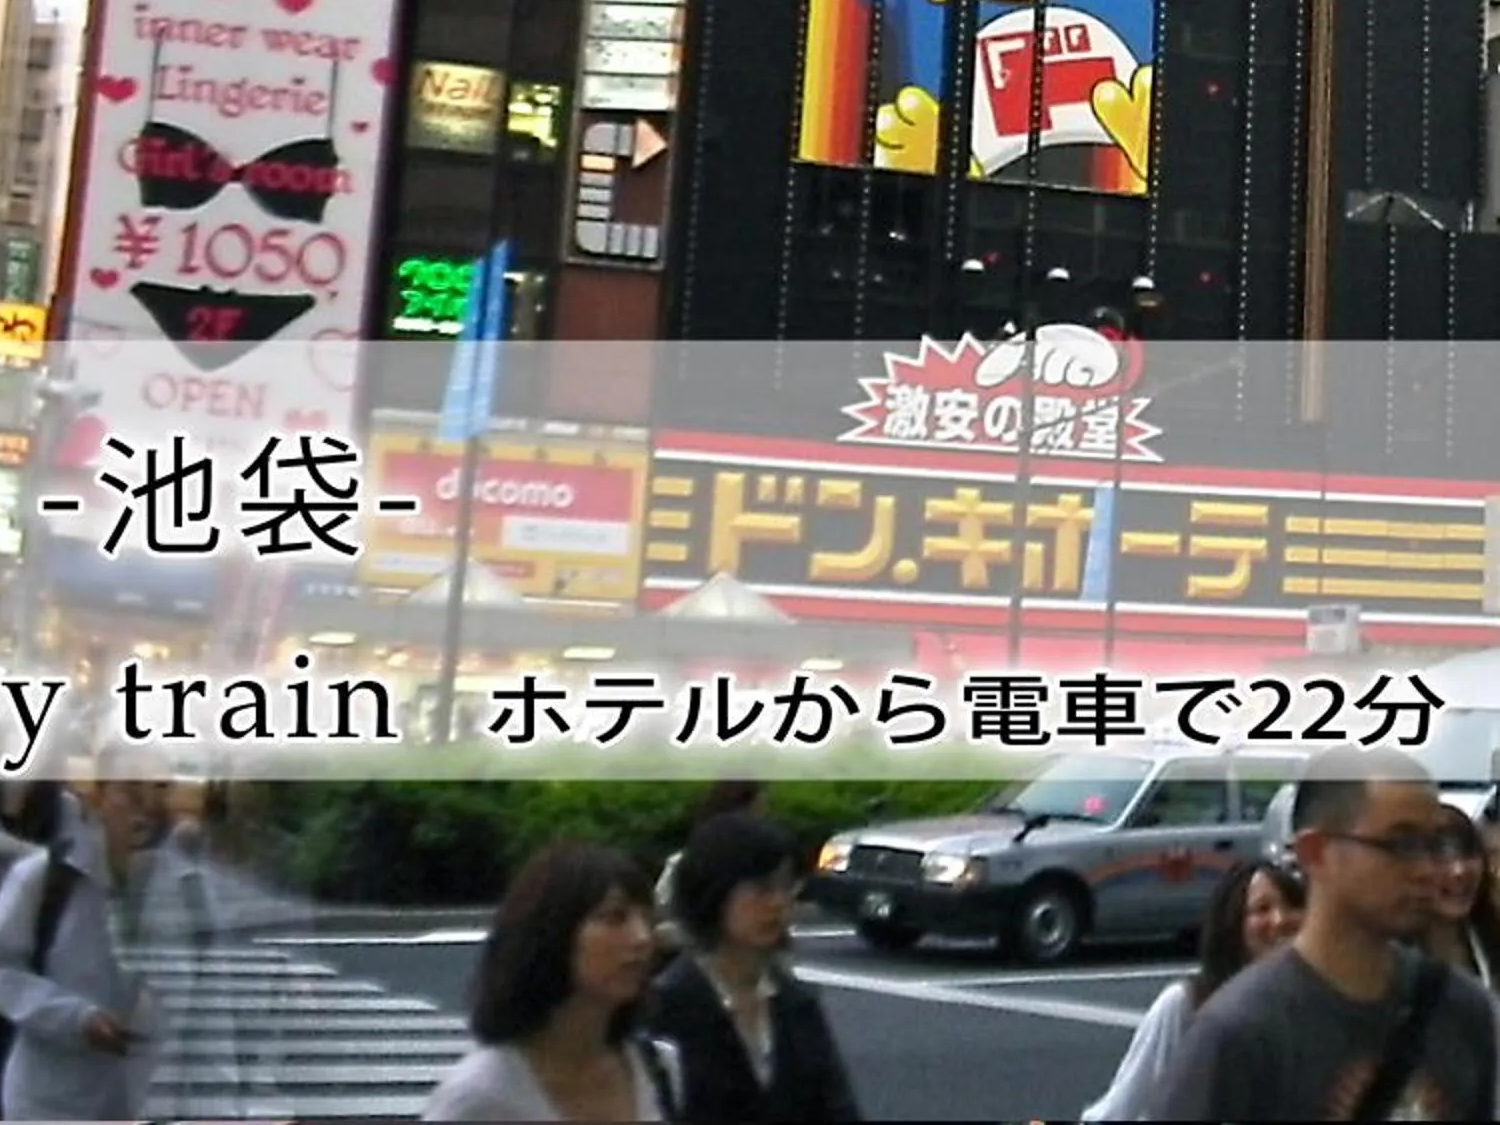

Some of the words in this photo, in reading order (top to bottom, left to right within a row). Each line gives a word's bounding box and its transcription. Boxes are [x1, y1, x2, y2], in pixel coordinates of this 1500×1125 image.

[133, 3, 250, 51] inner
[260, 25, 362, 63] wear
[155, 63, 329, 121] Lingerie
[141, 372, 269, 422] OPEN
[882, 383, 1122, 453] 激安の殿堂
[434, 469, 575, 509] dcomo
